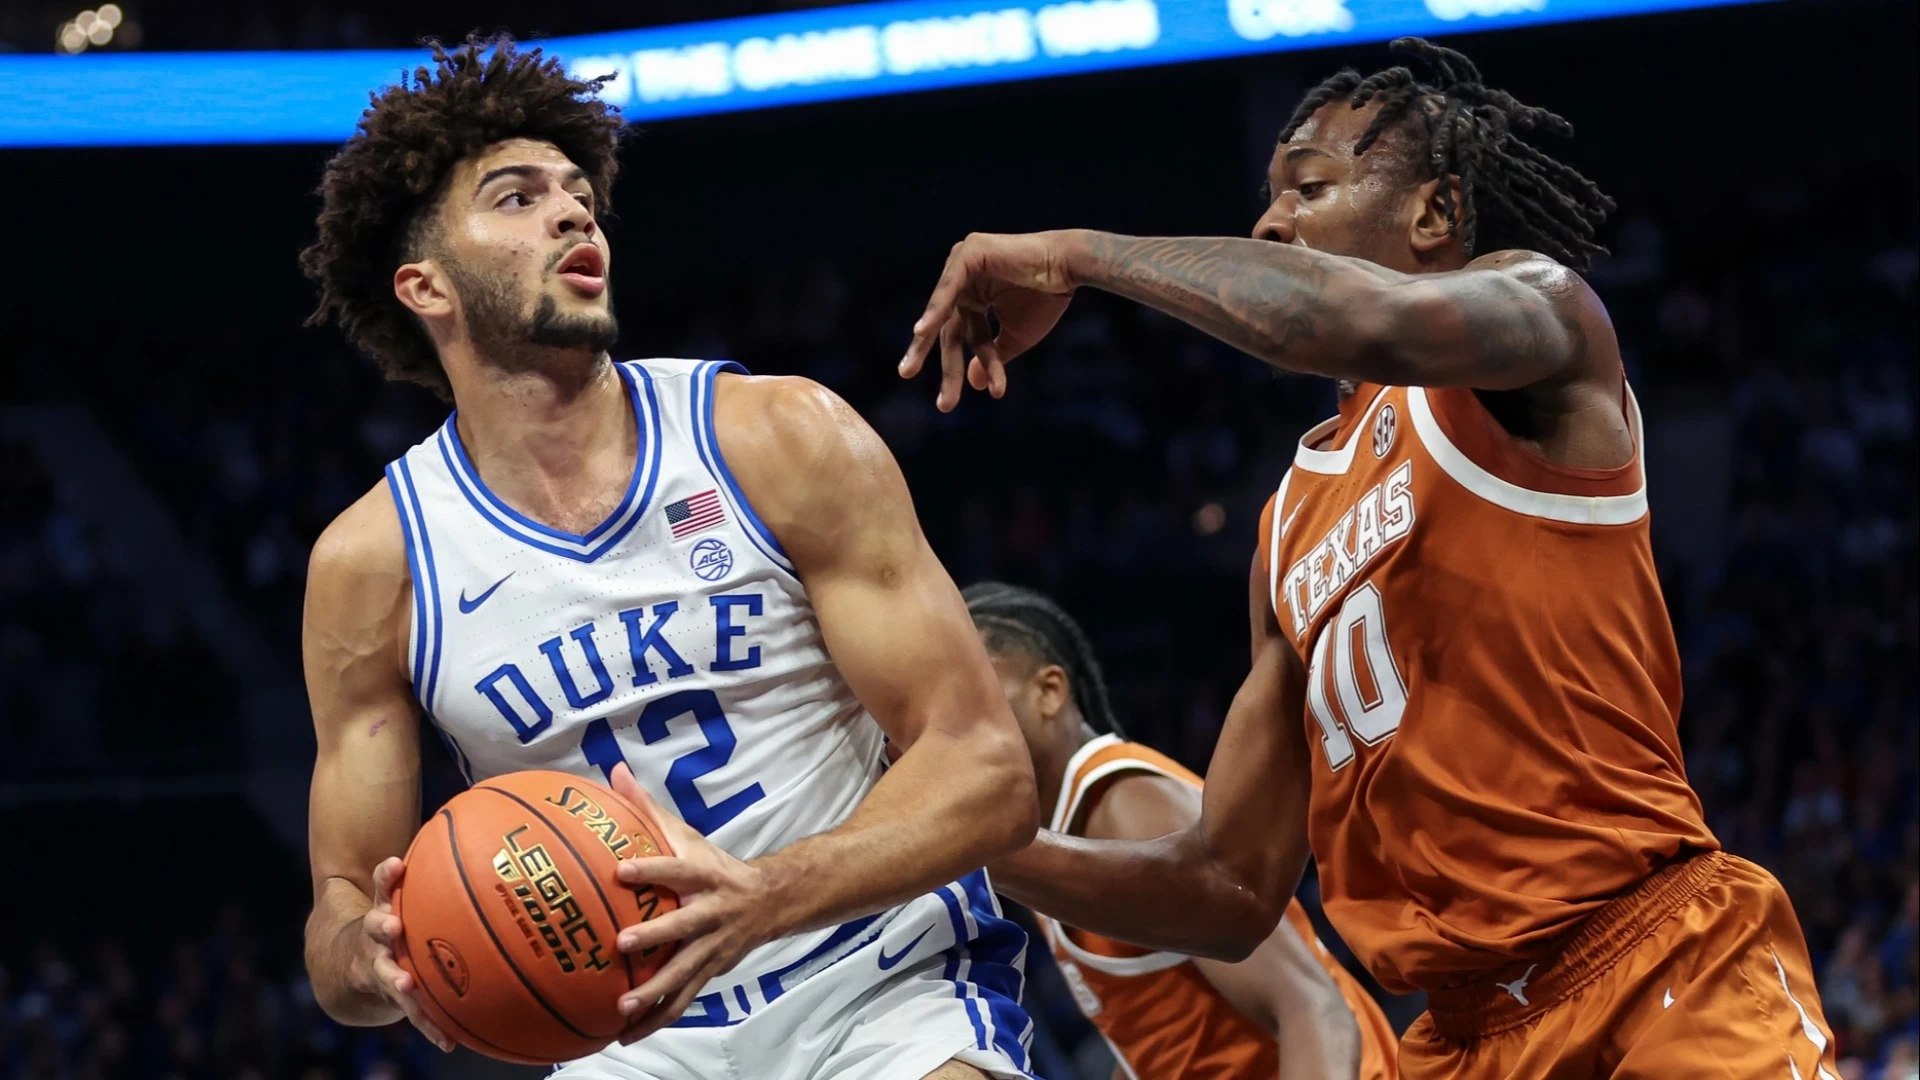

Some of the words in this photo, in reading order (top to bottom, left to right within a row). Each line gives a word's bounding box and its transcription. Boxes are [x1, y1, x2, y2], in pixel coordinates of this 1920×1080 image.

[1374, 406, 1395, 456] SEC
[697, 547, 728, 566] ACC
[1283, 458, 1416, 641] TEXAS
[475, 593, 763, 745] DUKE
[1308, 580, 1409, 773] 10
[580, 689, 767, 837] 12
[502, 822, 612, 972] LEGACY
[513, 882, 577, 974] 1000
[545, 786, 665, 958] SPALIN
